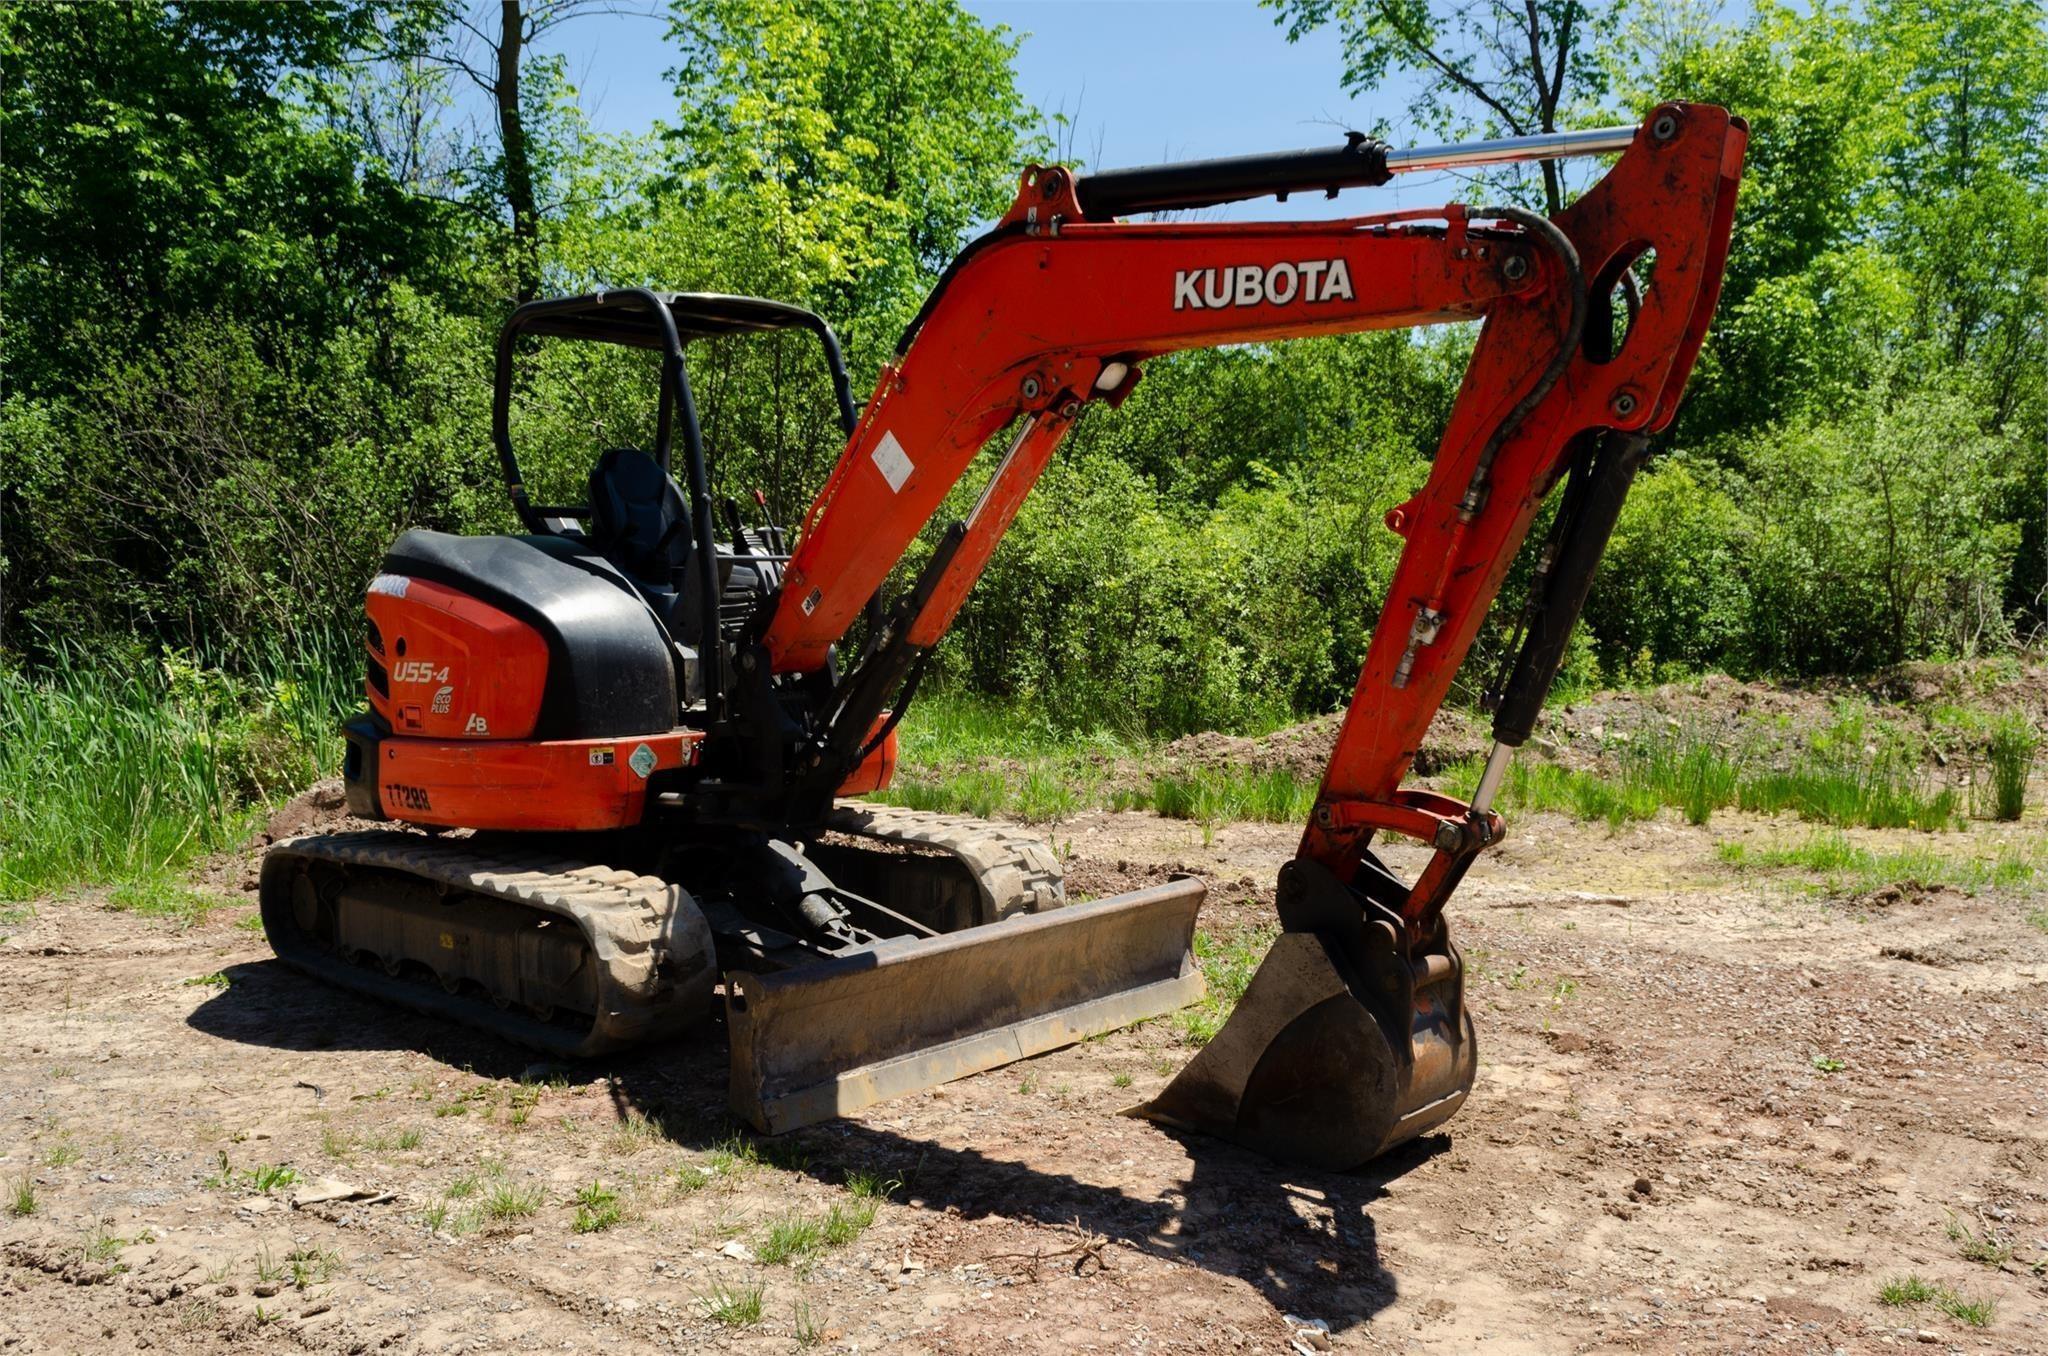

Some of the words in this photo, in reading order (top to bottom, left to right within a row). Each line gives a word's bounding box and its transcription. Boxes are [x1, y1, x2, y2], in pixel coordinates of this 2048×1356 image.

[1173, 258, 1355, 310] KUBOTA
[394, 662, 450, 683] U55-4
[431, 704, 450, 714] PLUS
